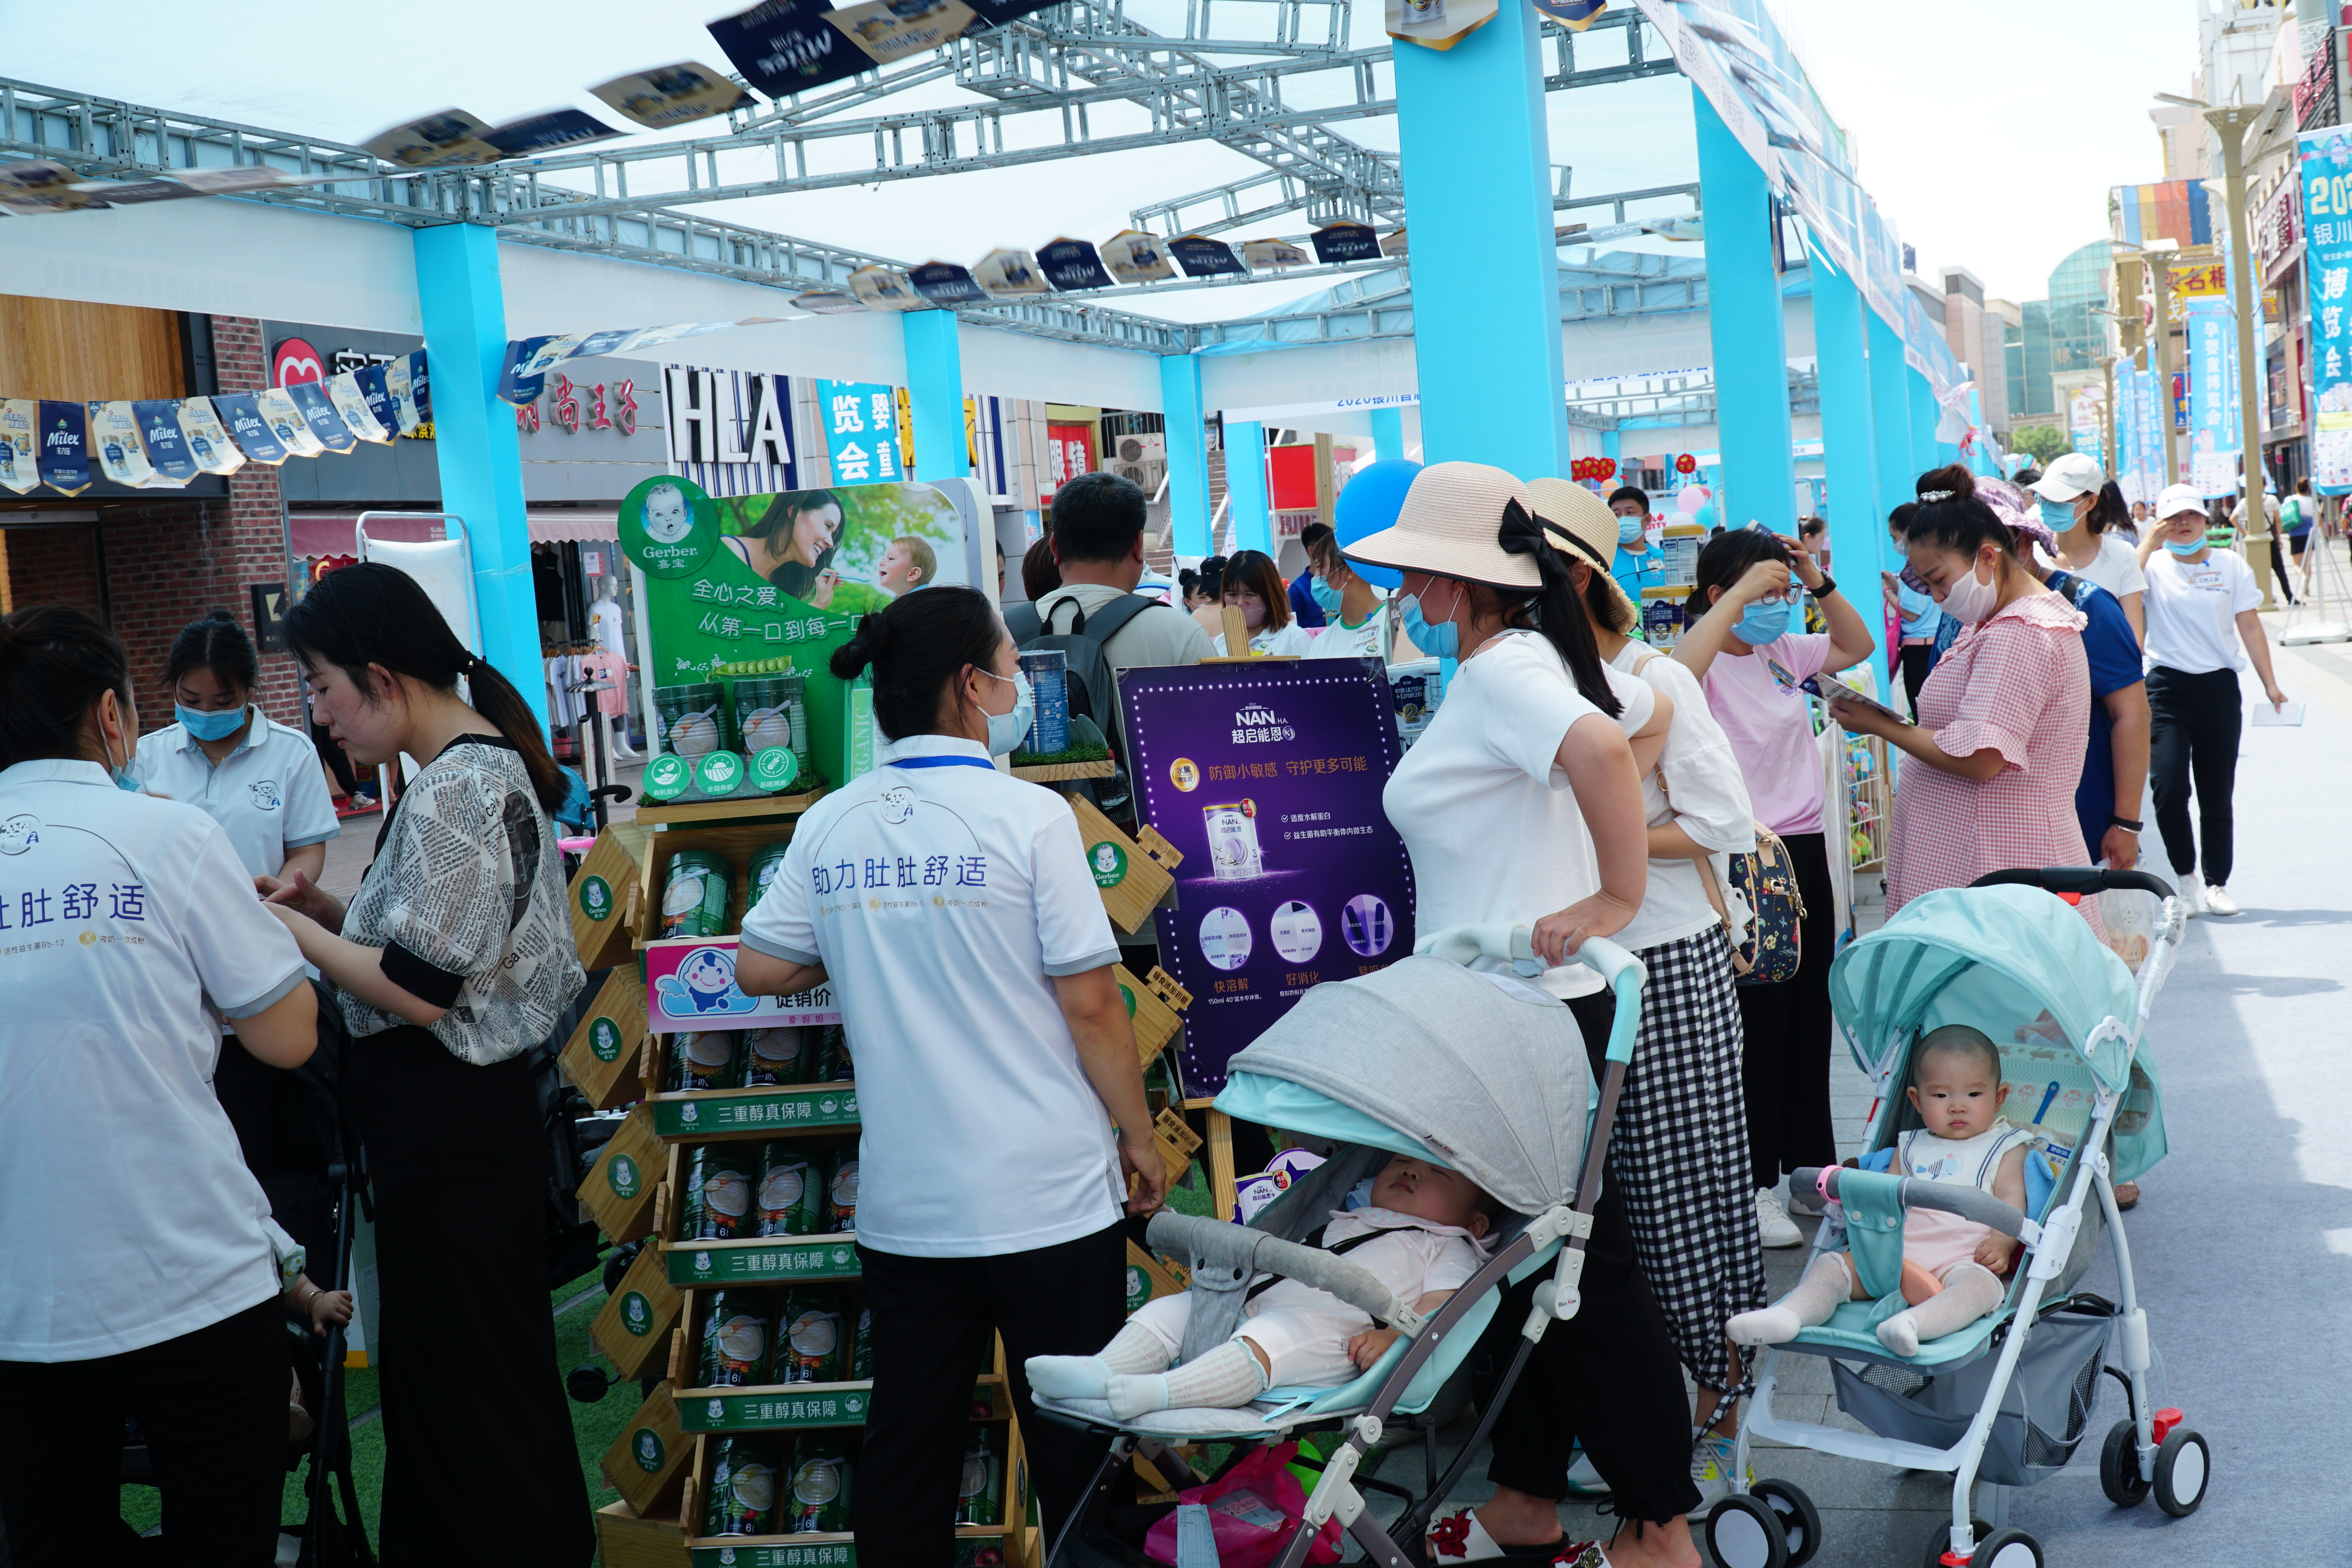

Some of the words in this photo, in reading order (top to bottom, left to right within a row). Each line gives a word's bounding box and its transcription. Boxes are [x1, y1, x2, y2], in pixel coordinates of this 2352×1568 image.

[365, 392, 386, 408] Milex
[307, 406, 331, 422] Milex
[666, 367, 791, 464] HLA
[235, 417, 261, 433] Milex
[47, 432, 80, 447] Milex
[150, 428, 178, 443] Milex
[871, 392, 896, 477] 婴童
[643, 546, 697, 559] Gerber
[657, 558, 686, 570] 嘉宝
[1235, 710, 1276, 726] NAN
[1403, 703, 1421, 724] 2
[854, 708, 870, 778] RGANIC
[1231, 726, 1283, 744] 超启能恩
[1177, 766, 1191, 775] 水解
[1209, 761, 1278, 781] 防御小敏感
[1285, 756, 1368, 777] 守护更多可能
[653, 787, 681, 796] 有机源头
[706, 784, 734, 793] 全链有机
[1290, 811, 1331, 823] 适度水解蛋白
[1293, 826, 1374, 840] 益生菌有助平衡体内微生态
[1252, 849, 1258, 858] 3
[812, 855, 987, 896] 助力肚肚舒适
[459, 895, 468, 913] member
[946, 899, 988, 908] 液奶一次成粉
[433, 904, 443, 927] rendered
[445, 905, 460, 935] influencing
[456, 916, 471, 945] Mulroney's
[465, 922, 478, 950] disclosure?
[4, 939, 65, 956] 活性益生菌Bb-12
[98, 934, 145, 946] 液奶一次成粉
[524, 962, 542, 989] GREGORY
[1285, 971, 1321, 987] 好消化
[1152, 971, 1189, 1005] 辅食添加初期
[1214, 978, 1250, 994] 快溶解
[1208, 996, 1225, 1005] 150ml
[718, 1101, 813, 1123] 三重醇真保障
[1161, 1114, 1197, 1149] 辅食添加初期
[731, 1251, 824, 1272] 三重醇真保障
[744, 1399, 837, 1420] 三重醇真保障
[756, 1547, 849, 1567] 三重醇真保障
